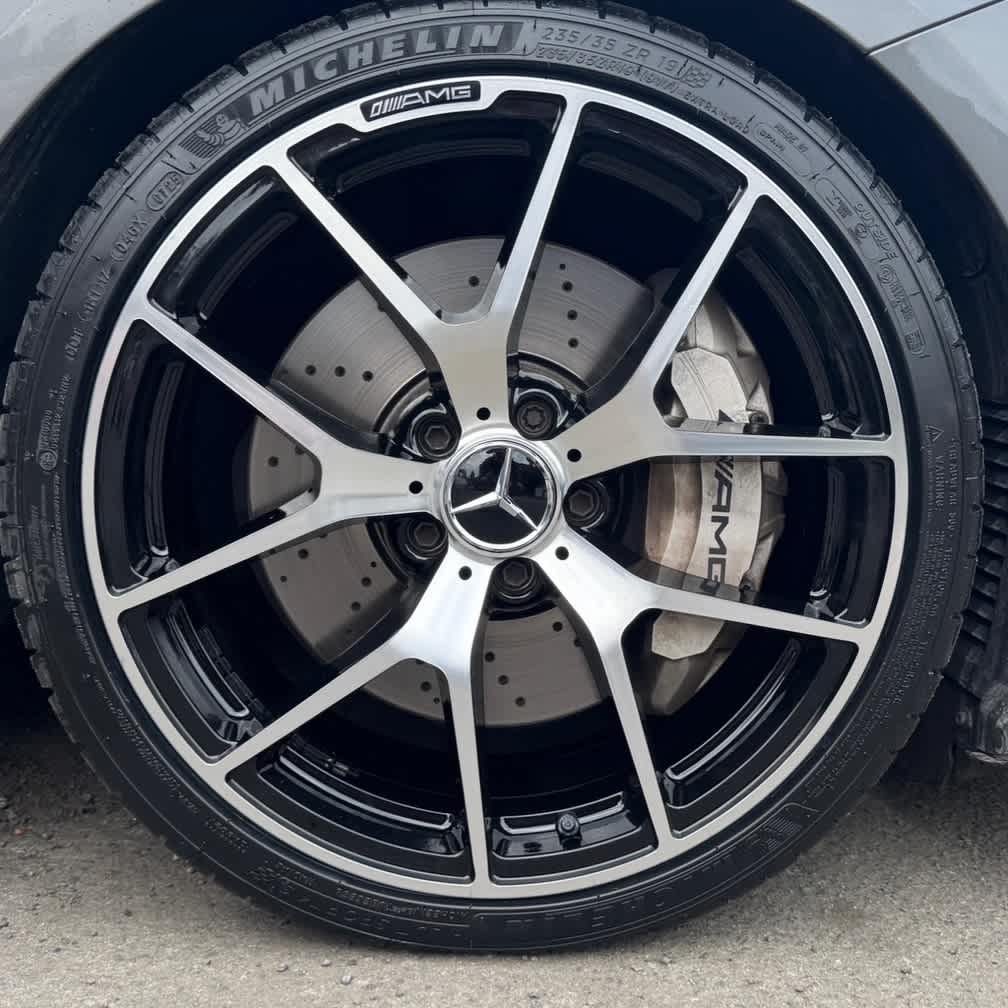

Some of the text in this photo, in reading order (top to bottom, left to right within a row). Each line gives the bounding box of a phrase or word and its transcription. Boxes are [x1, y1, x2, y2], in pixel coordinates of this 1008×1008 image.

[543, 27, 617, 52] 235/35
[249, 23, 504, 117] MICHELIN
[395, 84, 472, 111] AMG
